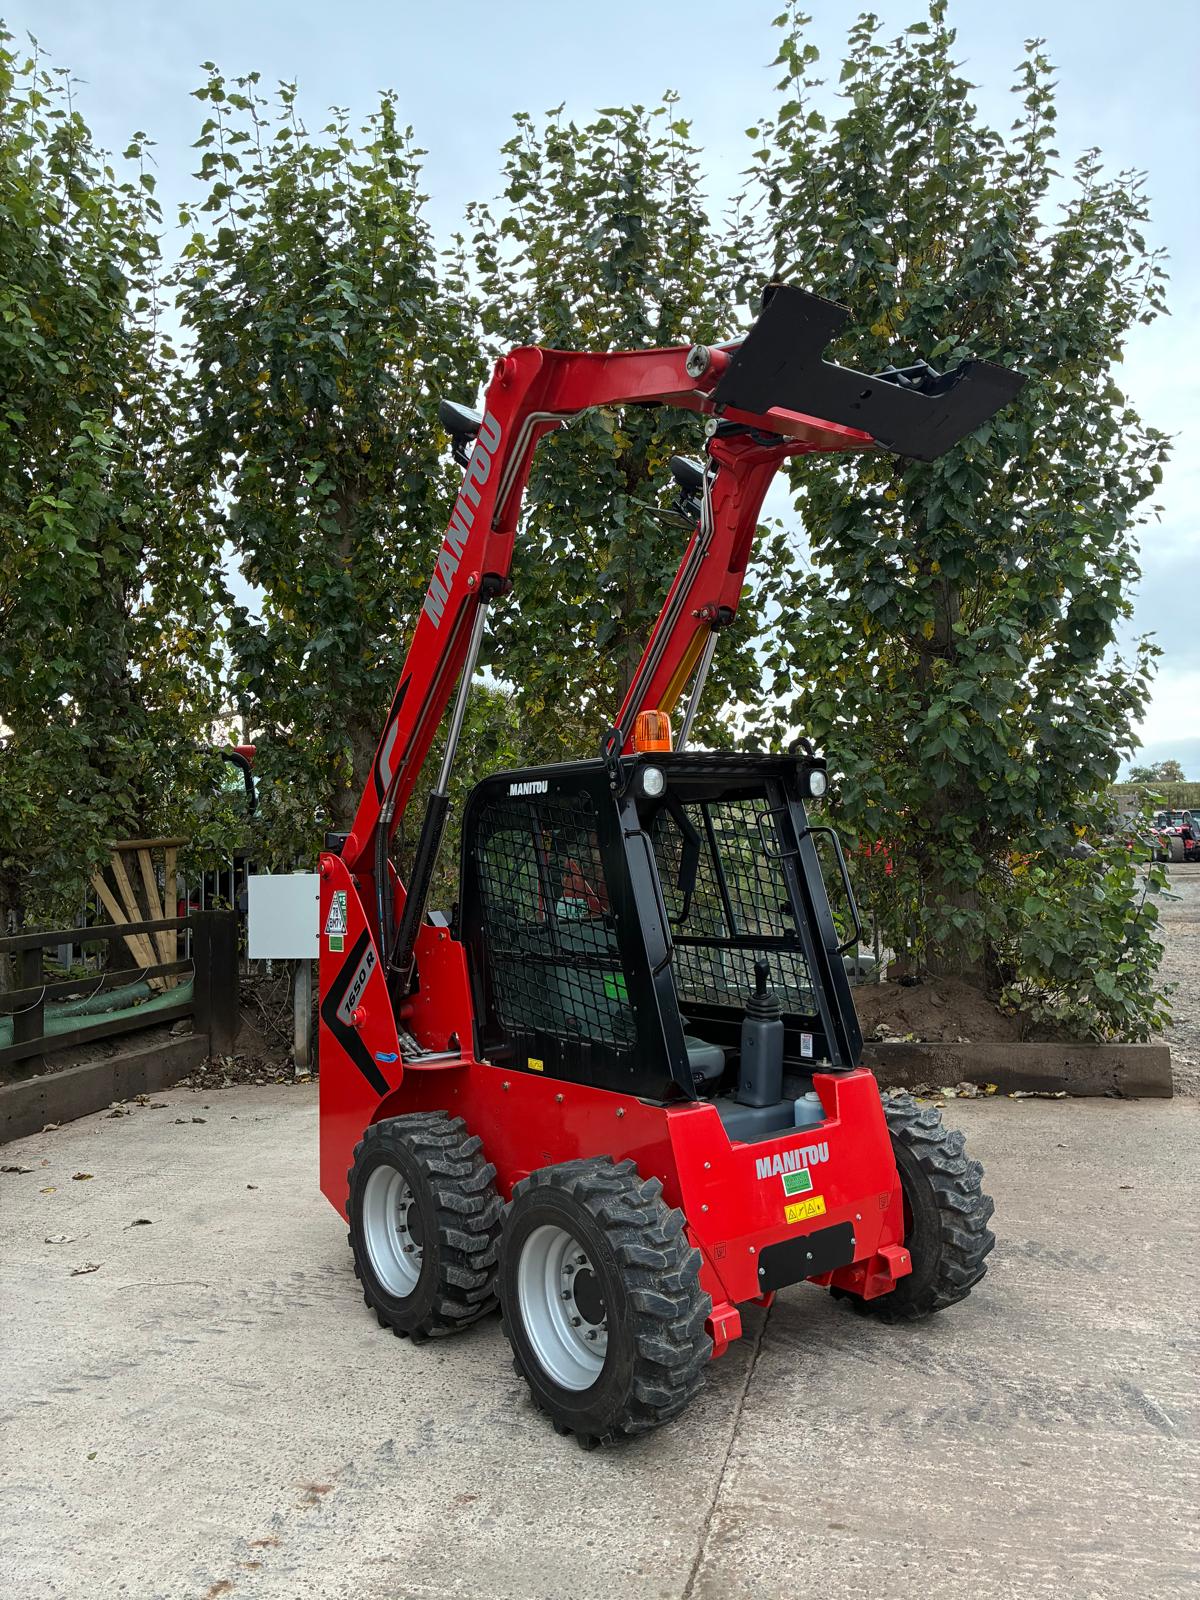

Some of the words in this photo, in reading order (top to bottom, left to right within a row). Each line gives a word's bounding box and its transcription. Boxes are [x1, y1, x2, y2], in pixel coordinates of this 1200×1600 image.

[423, 410, 502, 630] MANITOU
[509, 780, 548, 796] MANITOU
[344, 968, 366, 1013] 1650
[366, 951, 375, 968] R
[755, 1141, 830, 1180] MANITOU
